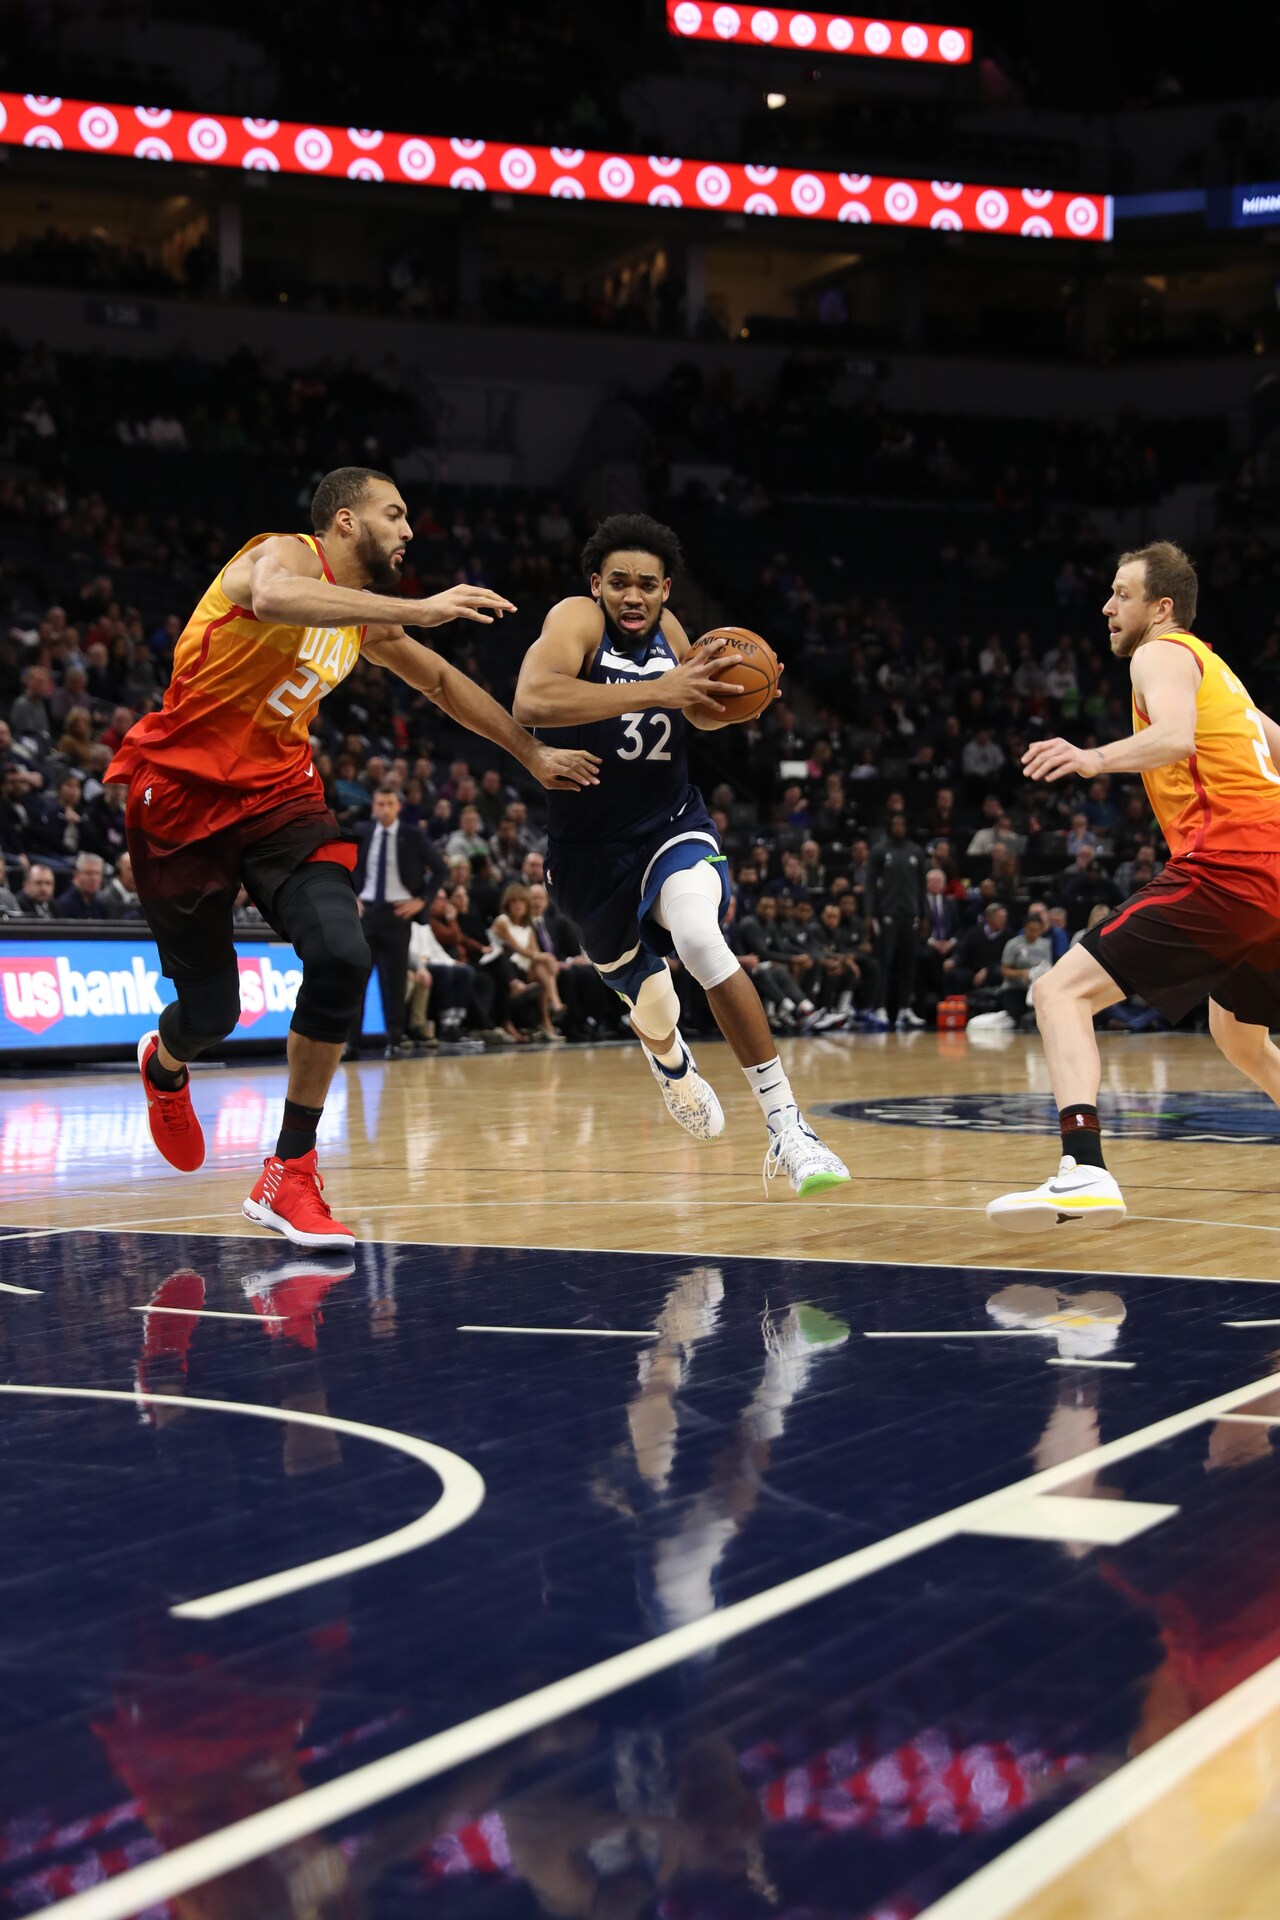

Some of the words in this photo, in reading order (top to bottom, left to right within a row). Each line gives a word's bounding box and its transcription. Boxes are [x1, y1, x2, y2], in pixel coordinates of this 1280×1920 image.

[299, 627, 357, 682] UTAH
[692, 636, 757, 658] SPALING
[617, 713, 671, 760] 32
